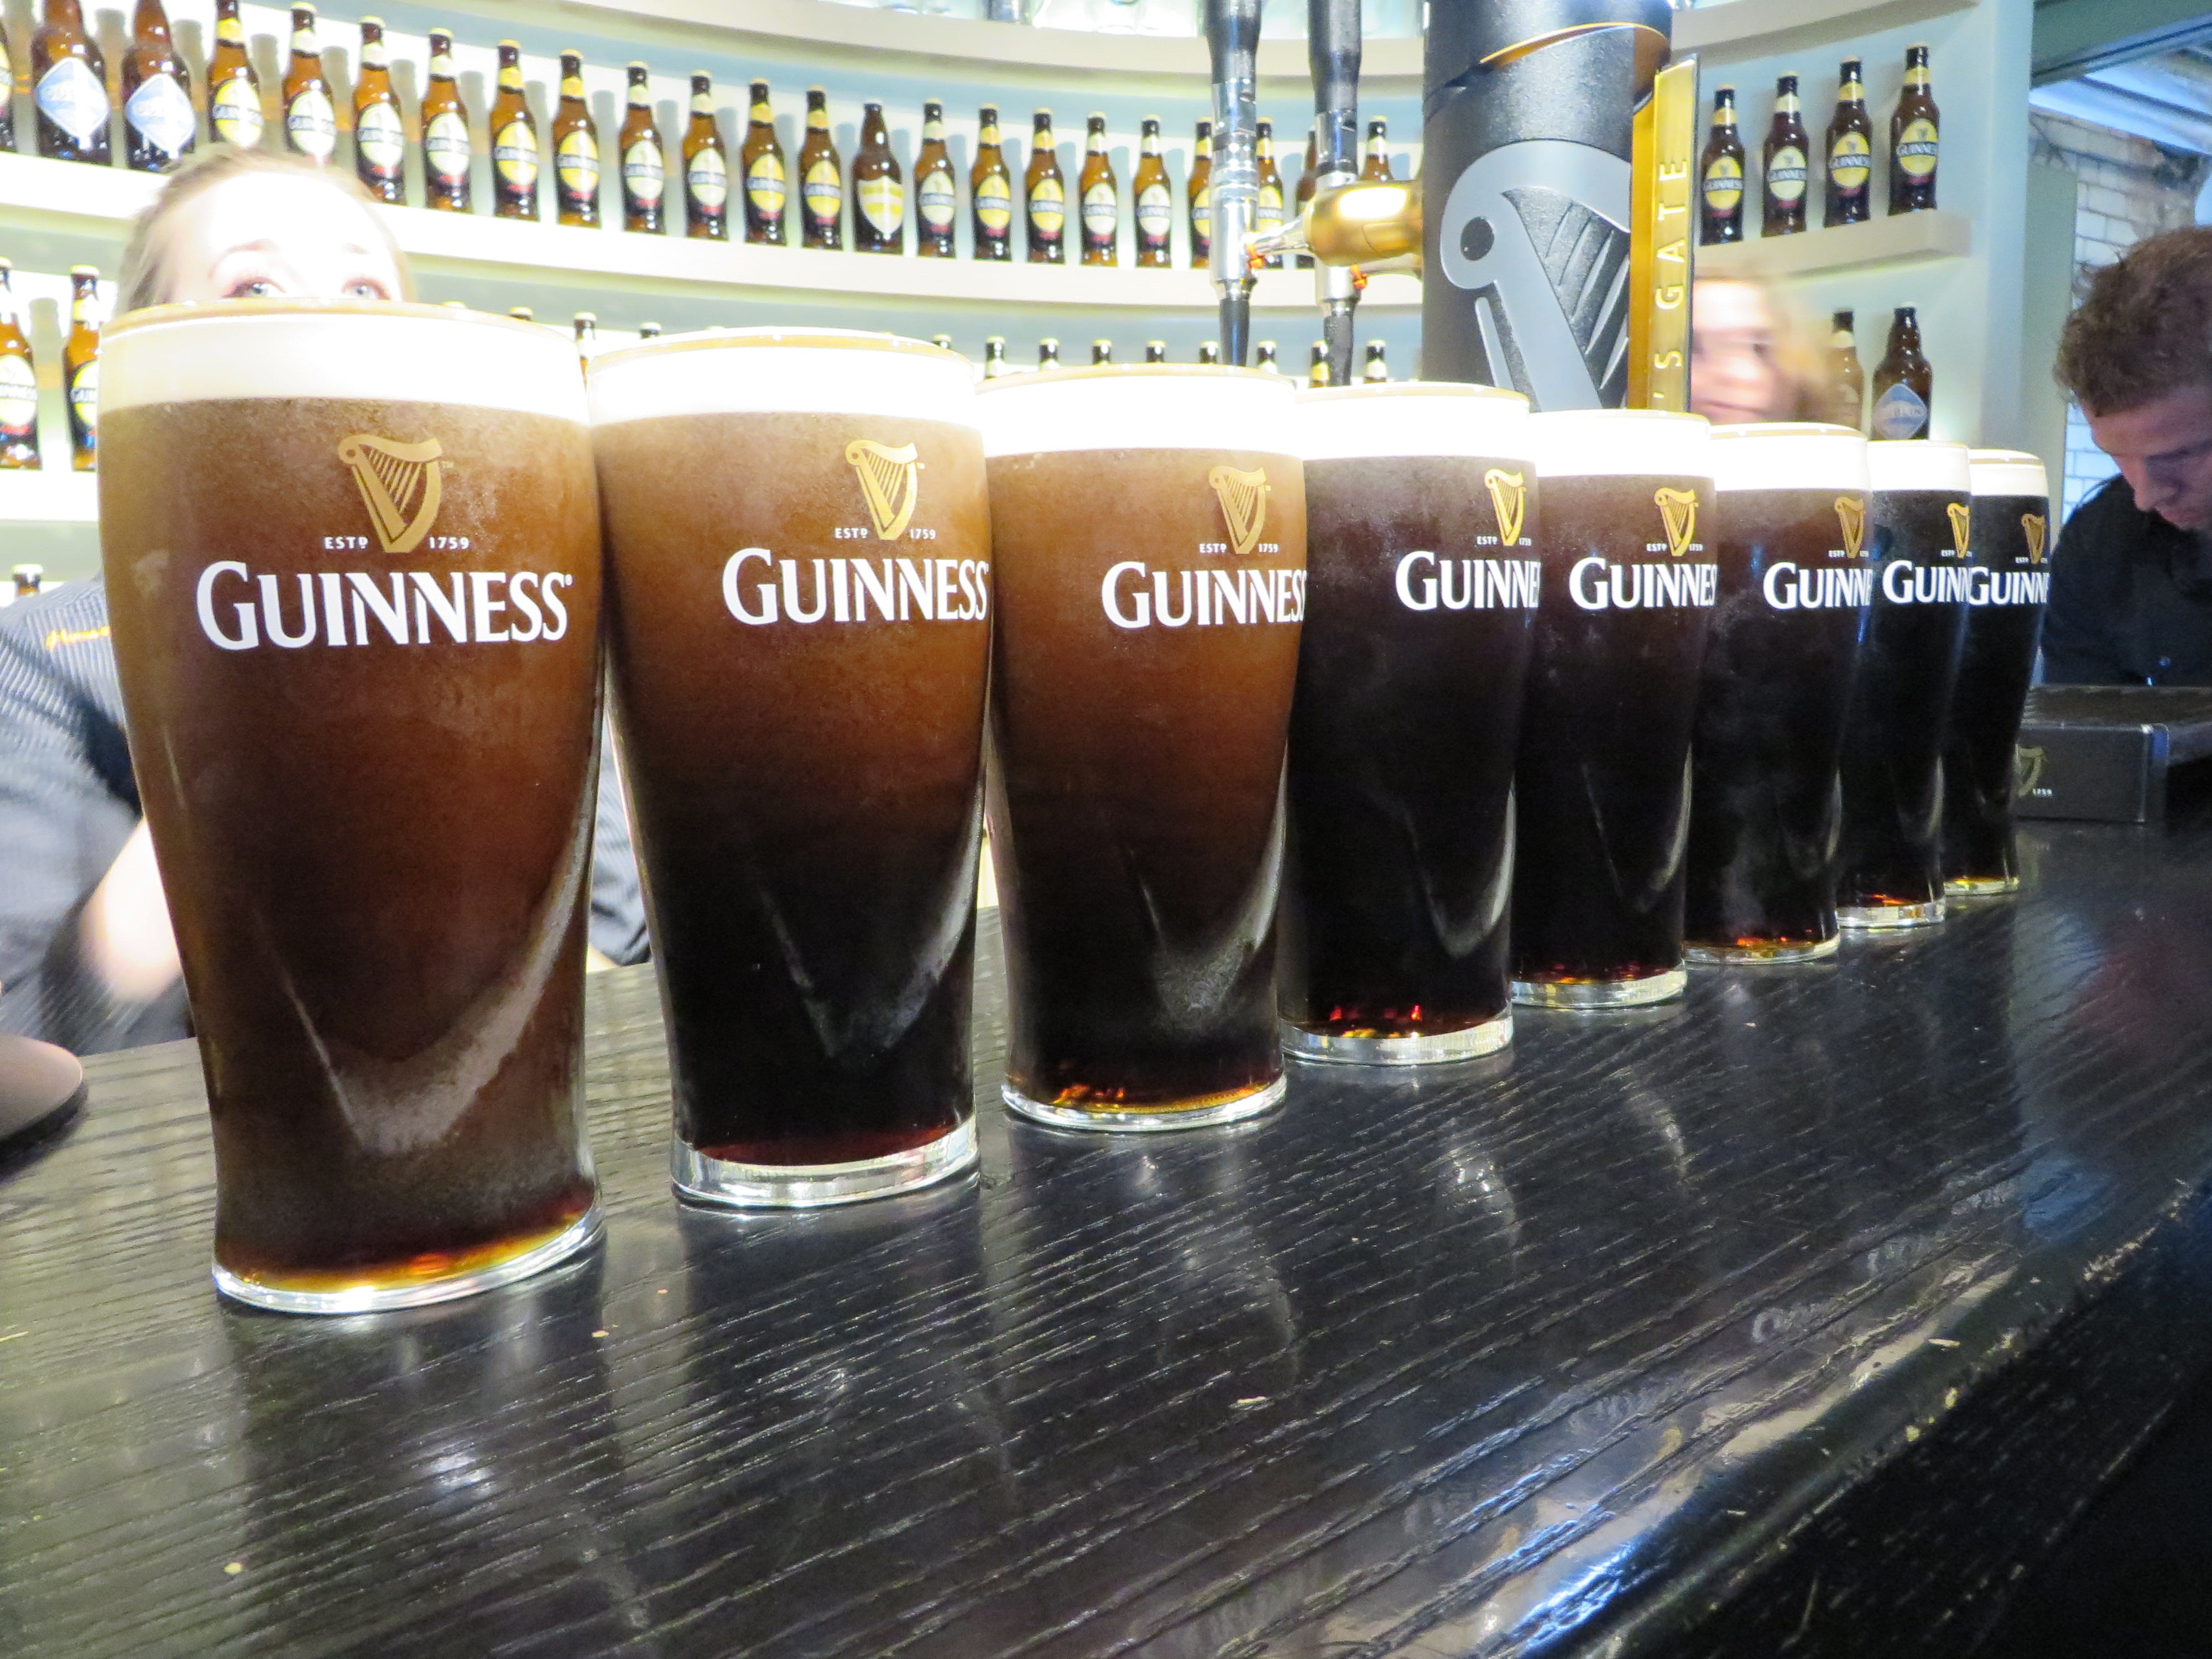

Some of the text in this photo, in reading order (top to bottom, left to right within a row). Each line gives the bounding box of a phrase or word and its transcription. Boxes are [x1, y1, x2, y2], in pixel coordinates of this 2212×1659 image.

[1655, 160, 1687, 310] GATE
[429, 537, 471, 550] 1759
[909, 528, 936, 540] 1759
[1258, 544, 1279, 553] 1759
[196, 560, 567, 650] GUINNESS
[722, 547, 988, 625] GUINNESS
